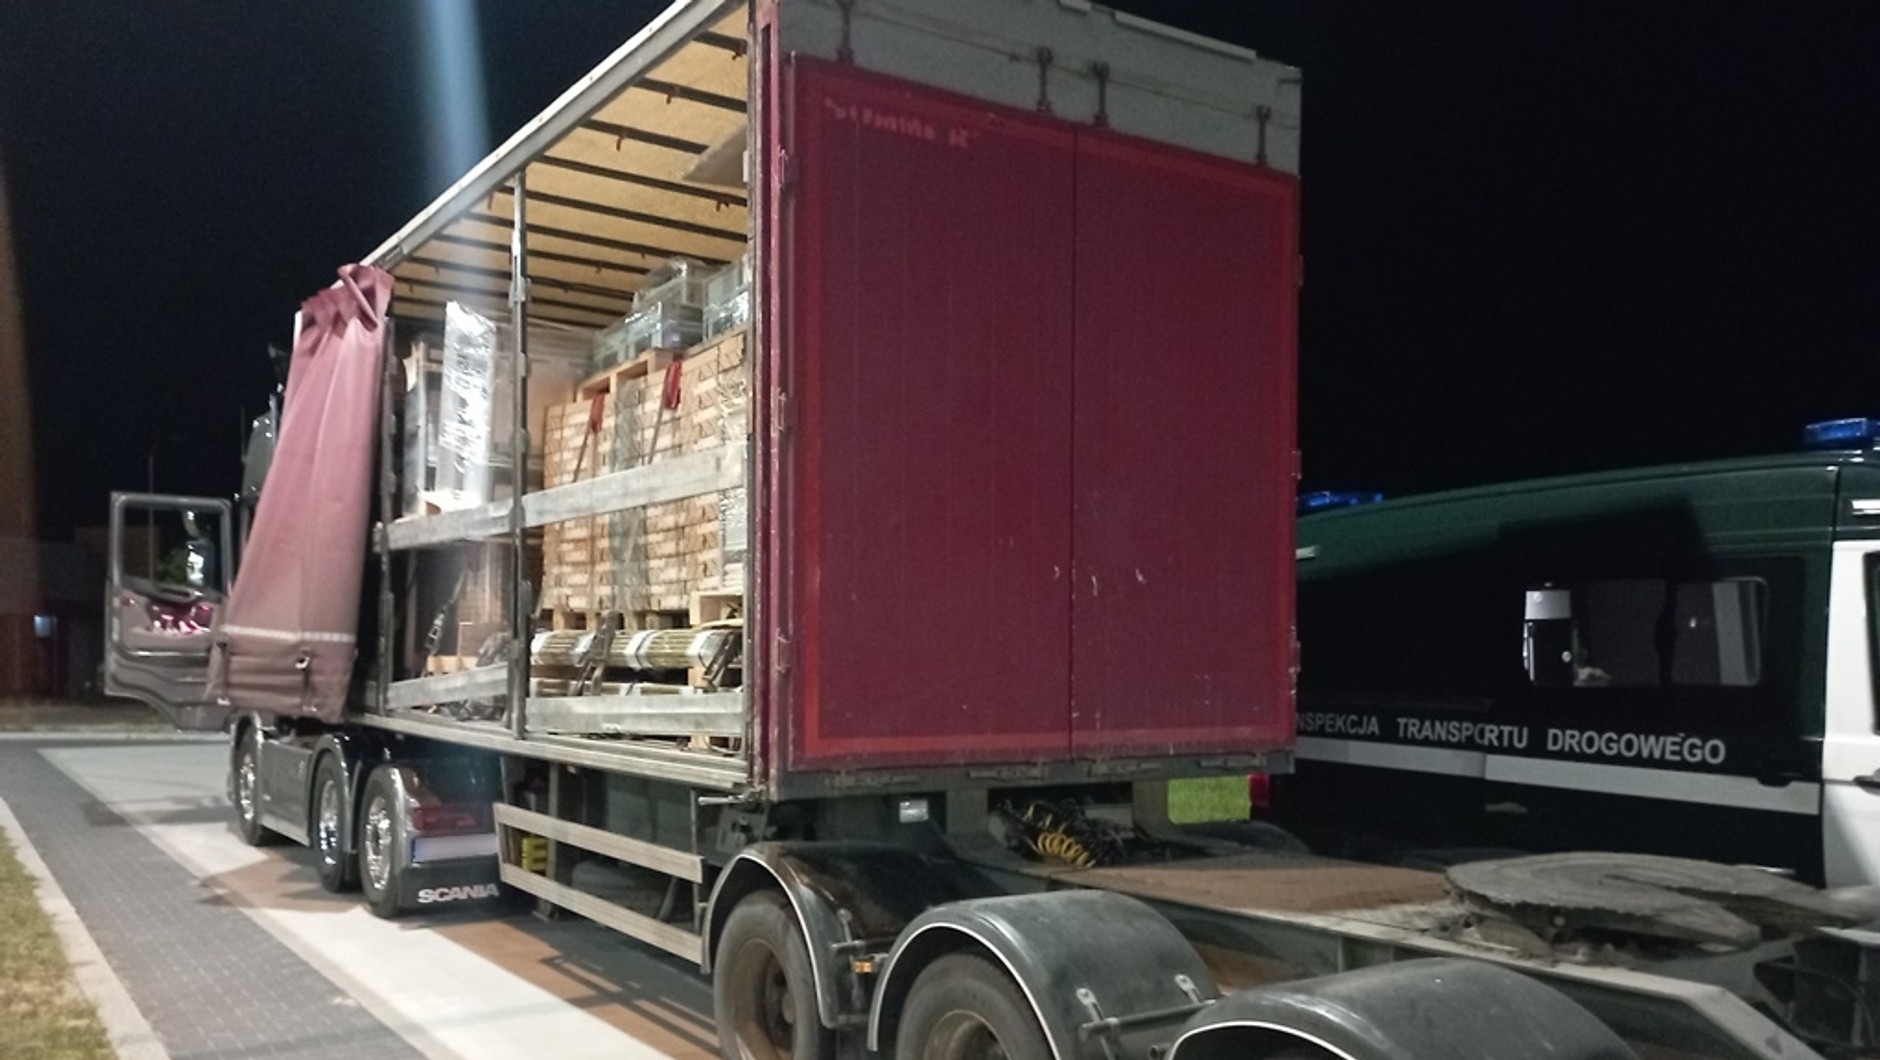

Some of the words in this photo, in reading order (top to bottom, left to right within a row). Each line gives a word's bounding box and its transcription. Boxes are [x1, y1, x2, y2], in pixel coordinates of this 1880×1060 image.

[1296, 713, 1379, 735] NSPEKCJA
[1547, 729, 1726, 764] DROGOWEGO
[417, 884, 499, 903] SCANIA
